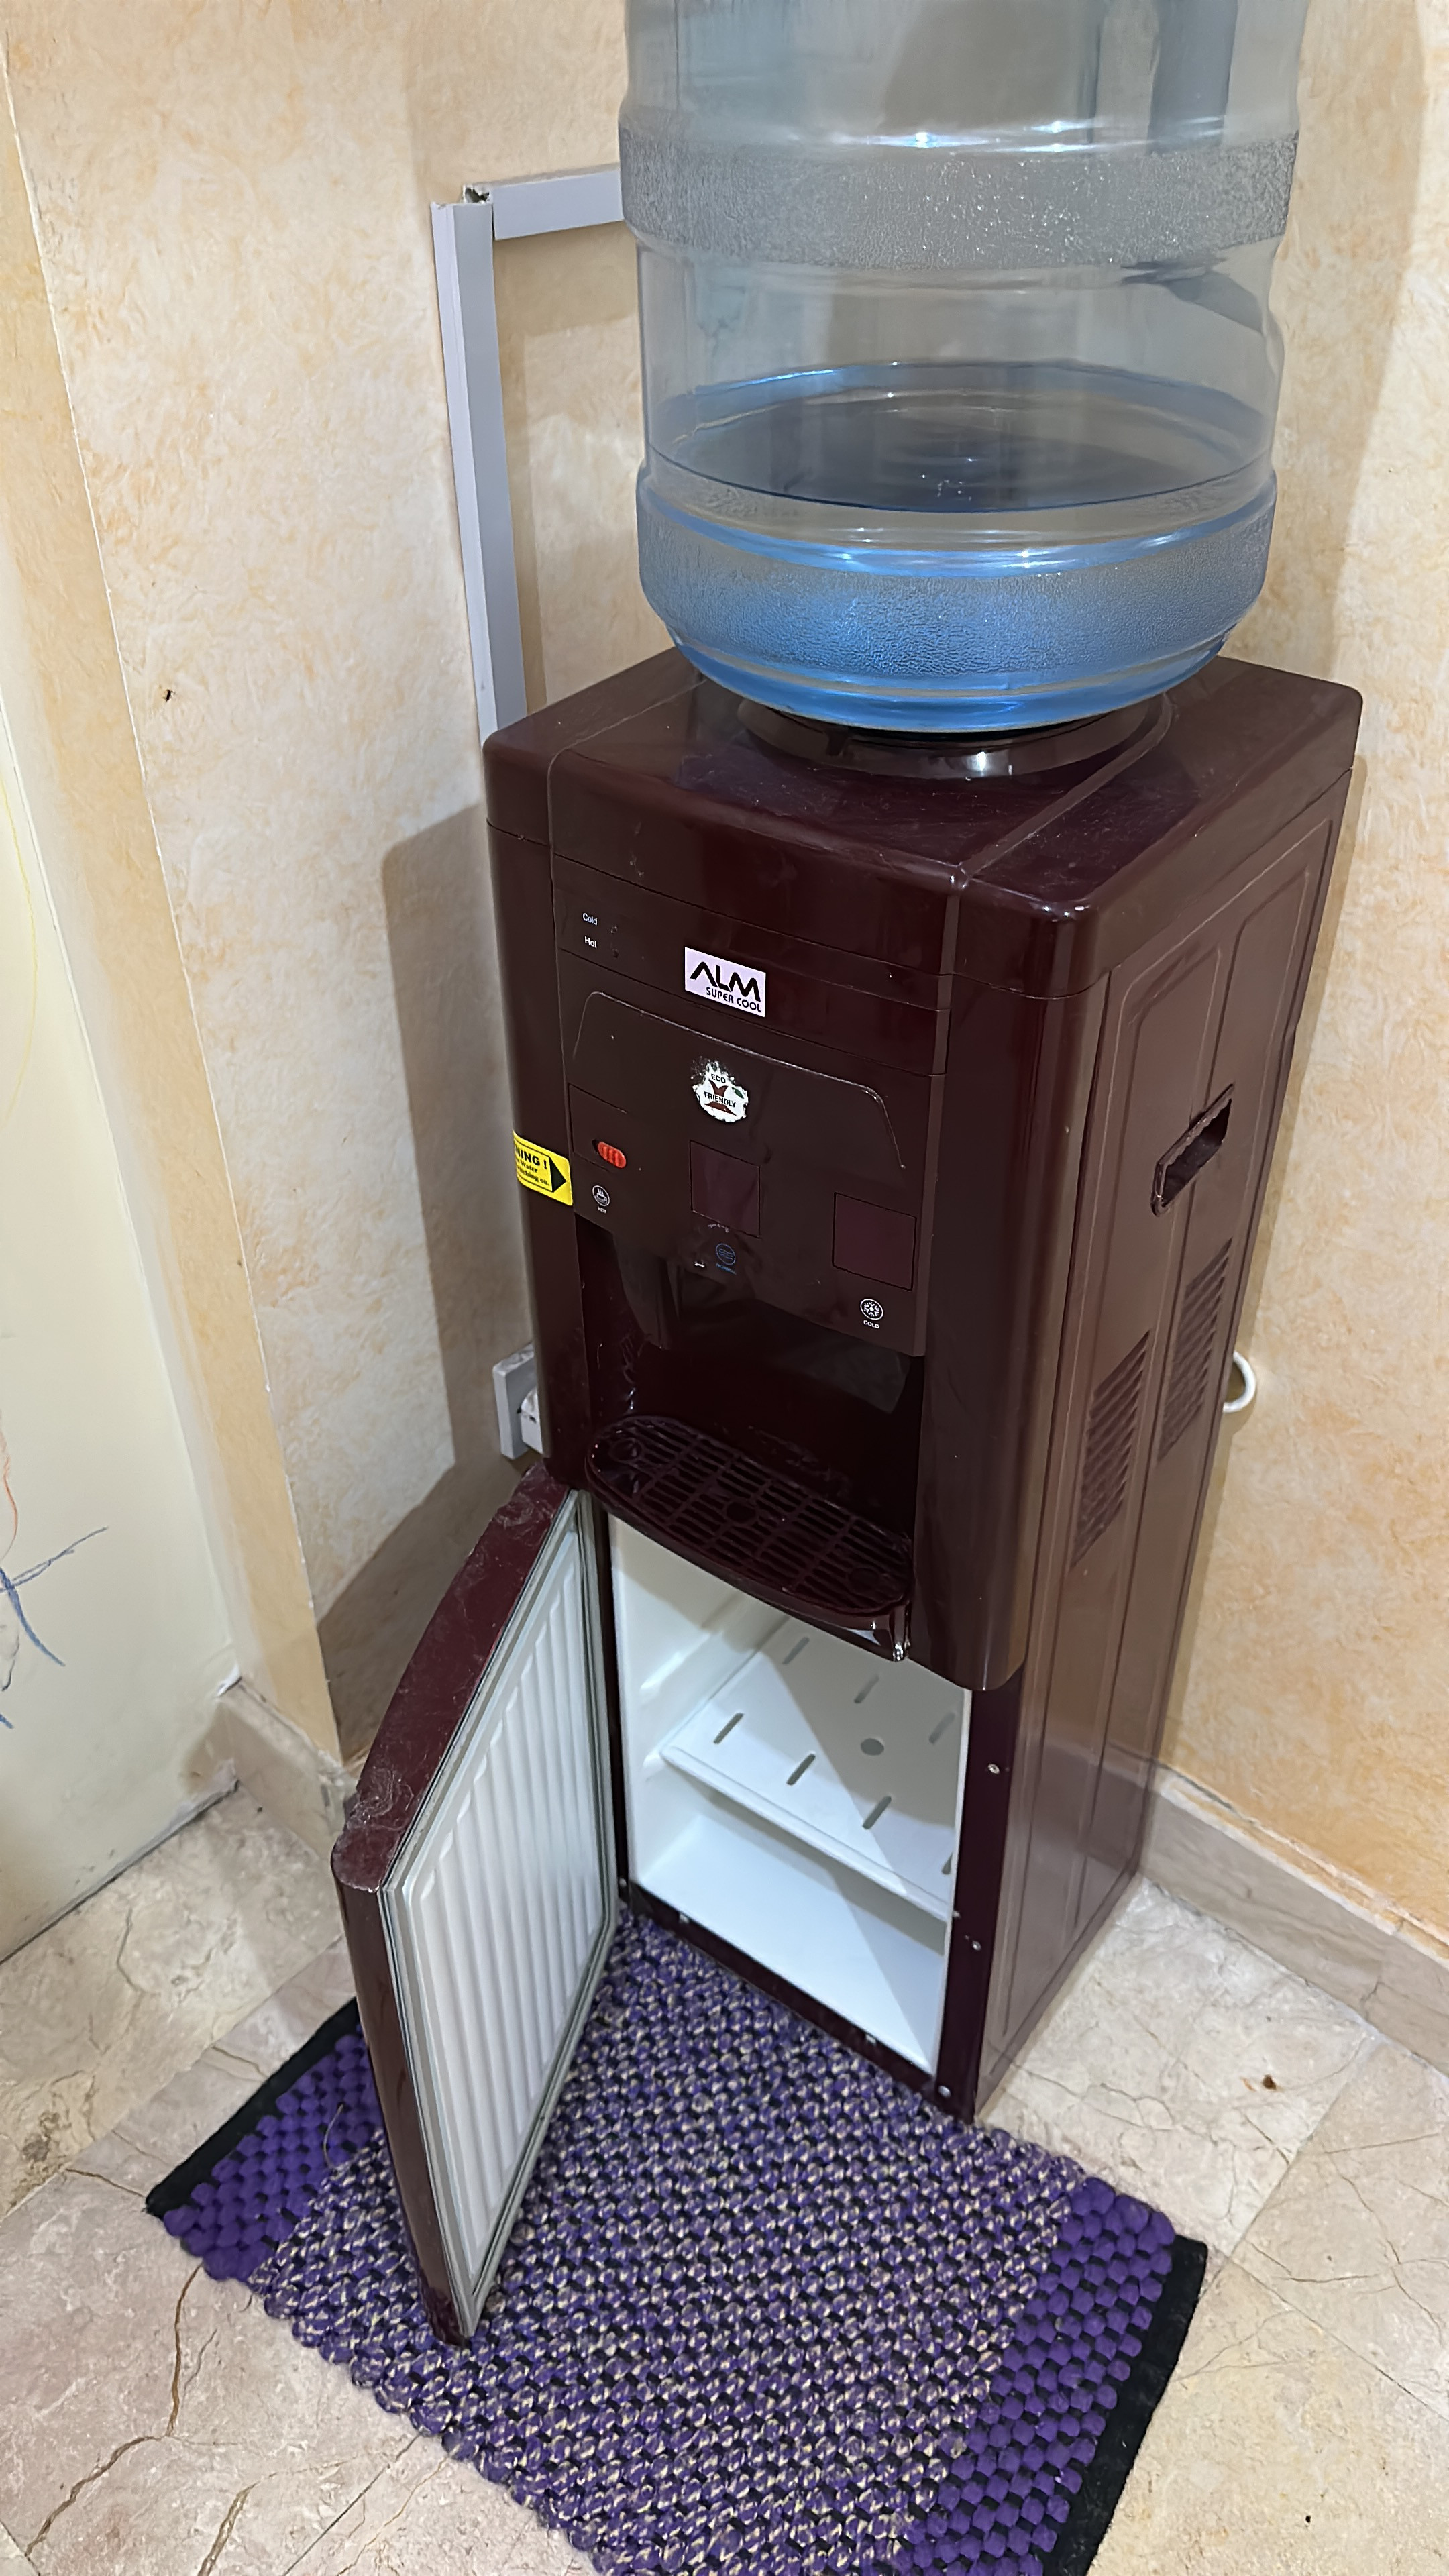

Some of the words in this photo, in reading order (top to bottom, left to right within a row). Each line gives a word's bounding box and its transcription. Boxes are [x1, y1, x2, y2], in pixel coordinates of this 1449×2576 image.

[582, 912, 598, 926] Cold
[584, 936, 597, 949] Hot
[690, 961, 761, 1002] ALM
[706, 987, 734, 1004] SUPER
[737, 998, 761, 1013] COOL
[711, 1073, 727, 1084] ECO
[704, 1091, 736, 1108] FRIENDLY
[863, 1320, 879, 1329] COLD
